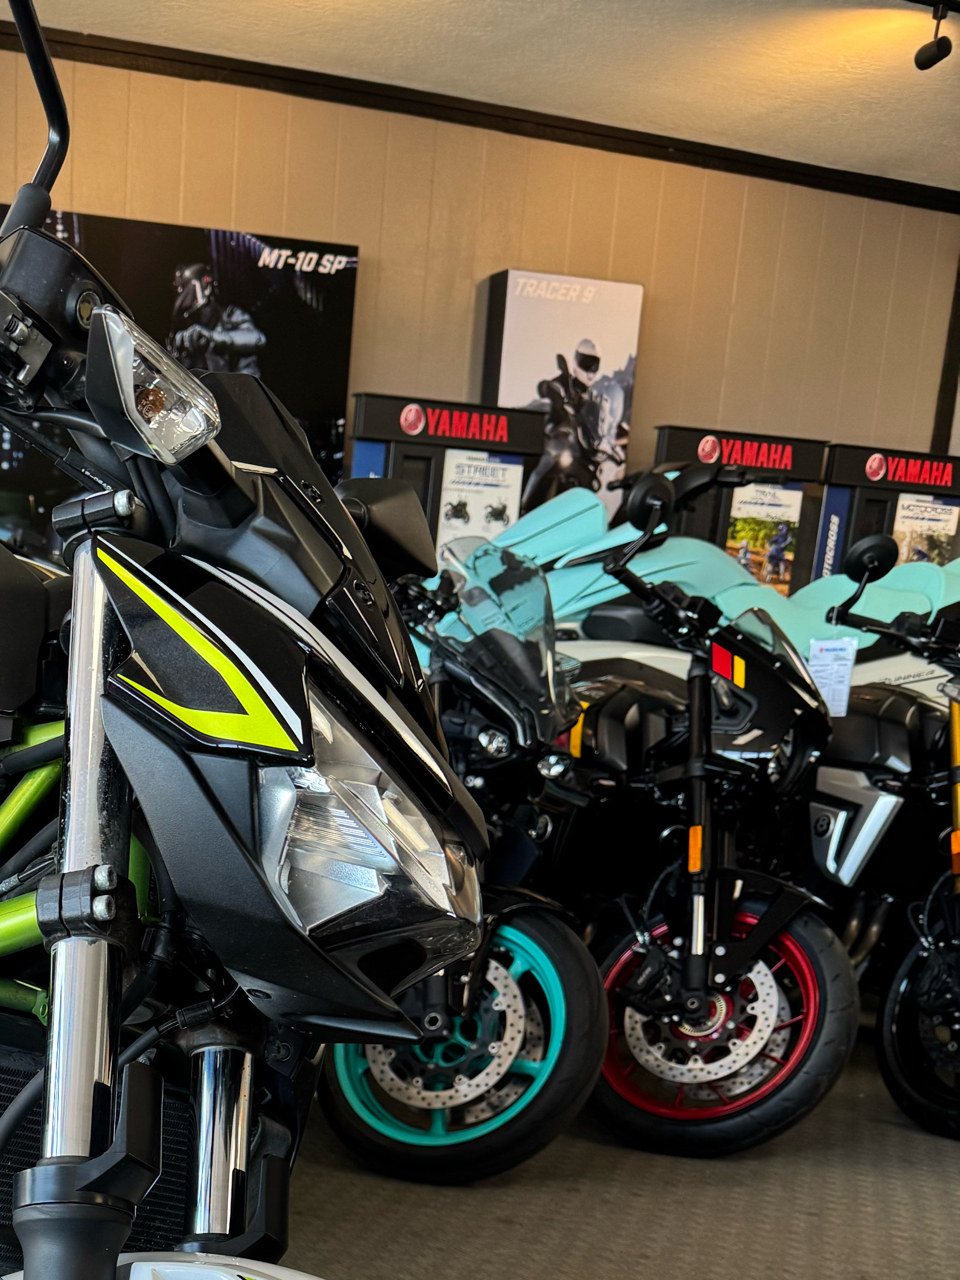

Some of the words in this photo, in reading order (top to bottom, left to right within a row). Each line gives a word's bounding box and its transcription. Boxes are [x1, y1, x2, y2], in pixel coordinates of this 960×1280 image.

[257, 247, 320, 272] MT-10
[317, 253, 348, 275] SP
[514, 278, 581, 302] TRACER
[581, 286, 596, 304] 9
[425, 407, 508, 443] YAMAHA
[721, 438, 793, 471] YAMAHA
[886, 456, 953, 488] YAMAHA
[822, 514, 840, 578] OTOCROSS
